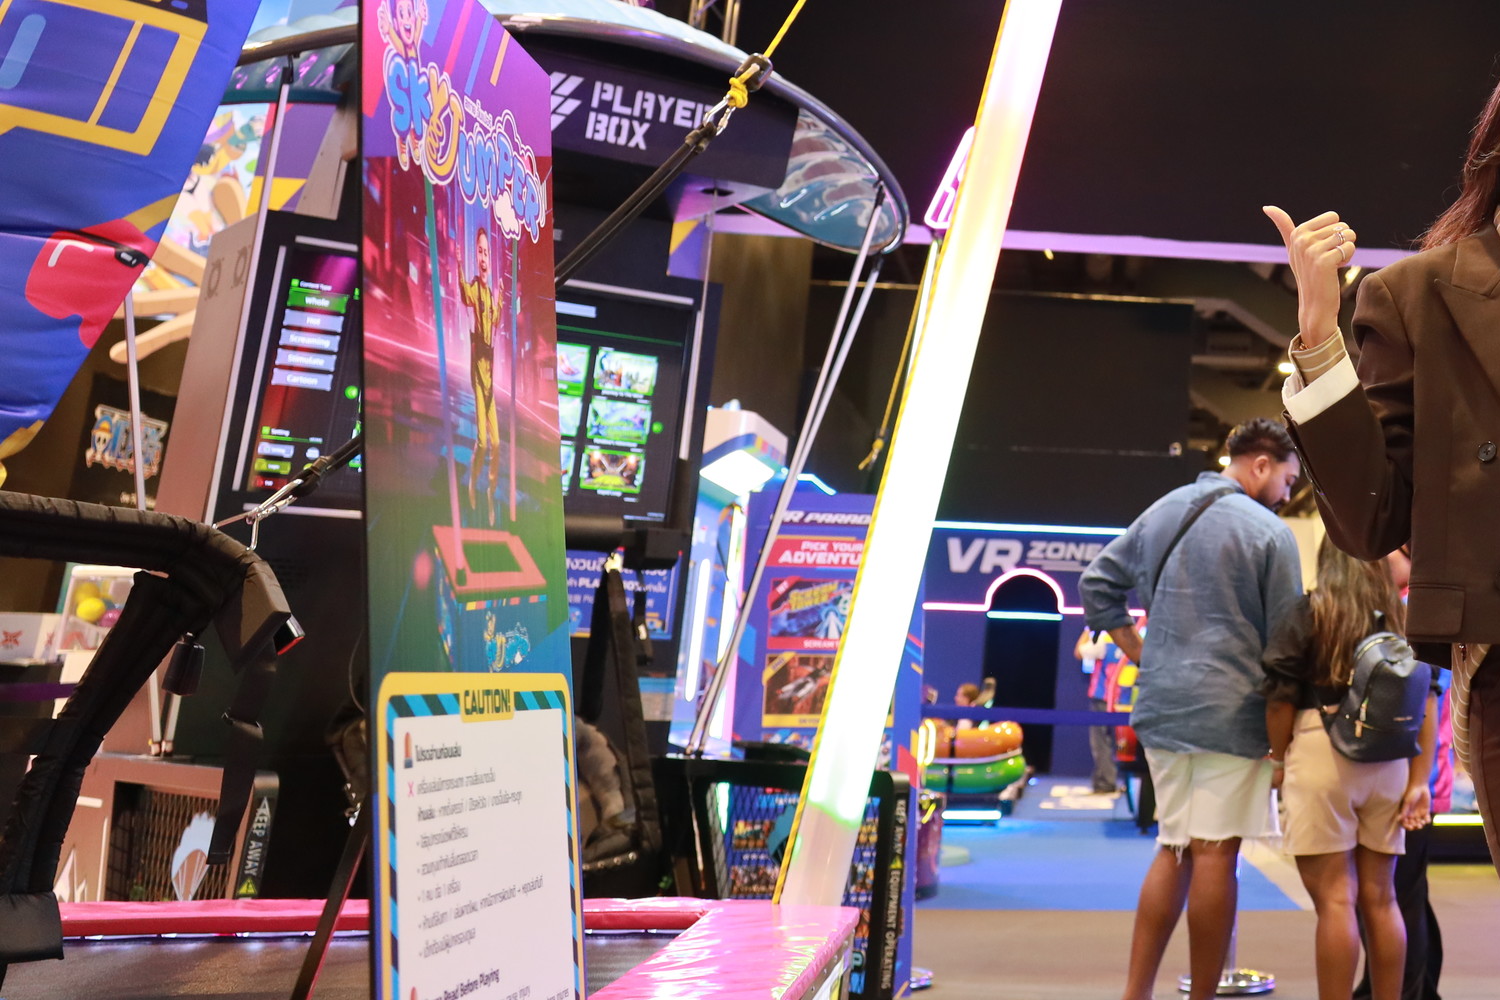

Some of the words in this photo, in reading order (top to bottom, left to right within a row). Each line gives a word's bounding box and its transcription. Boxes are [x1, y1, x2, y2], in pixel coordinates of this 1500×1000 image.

[585, 111, 651, 151] BOX
[305, 296, 330, 307] Whole
[289, 334, 331, 347] Screaming
[286, 374, 318, 386] Cartoon
[778, 550, 862, 565] ADVENTU
[801, 541, 829, 552] PICK
[947, 537, 1024, 574] VR
[1026, 540, 1105, 562] ZONE
[463, 689, 511, 716] CAUTION!
[253, 807, 269, 837] KEEP
[244, 841, 263, 876] AWAY
[881, 929, 897, 990] OPERATING
[460, 978, 478, 997] Before
[479, 967, 500, 986] Playing
